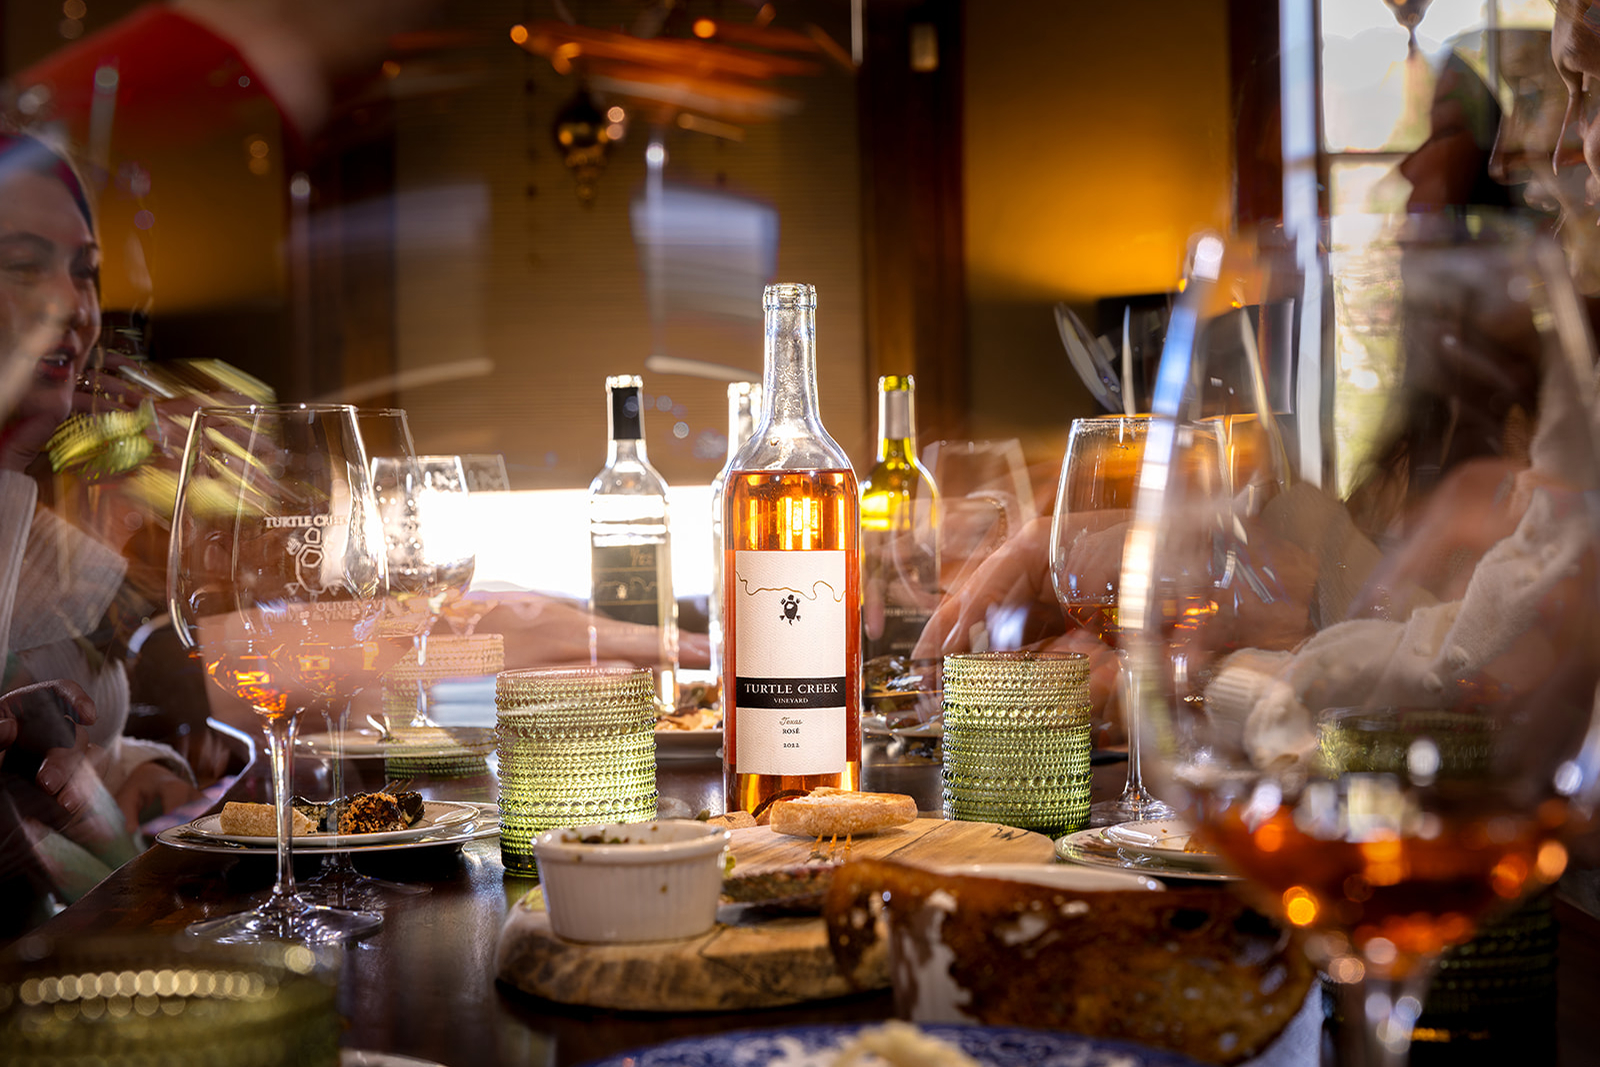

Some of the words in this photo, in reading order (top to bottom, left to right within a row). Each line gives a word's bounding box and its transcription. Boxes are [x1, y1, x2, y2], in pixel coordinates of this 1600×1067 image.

[264, 515, 312, 528] TURTLE
[744, 683, 793, 694] TURTLE
[797, 683, 838, 694] CREEK
[779, 716, 803, 726] Texas
[782, 727, 800, 735] ROSÉ
